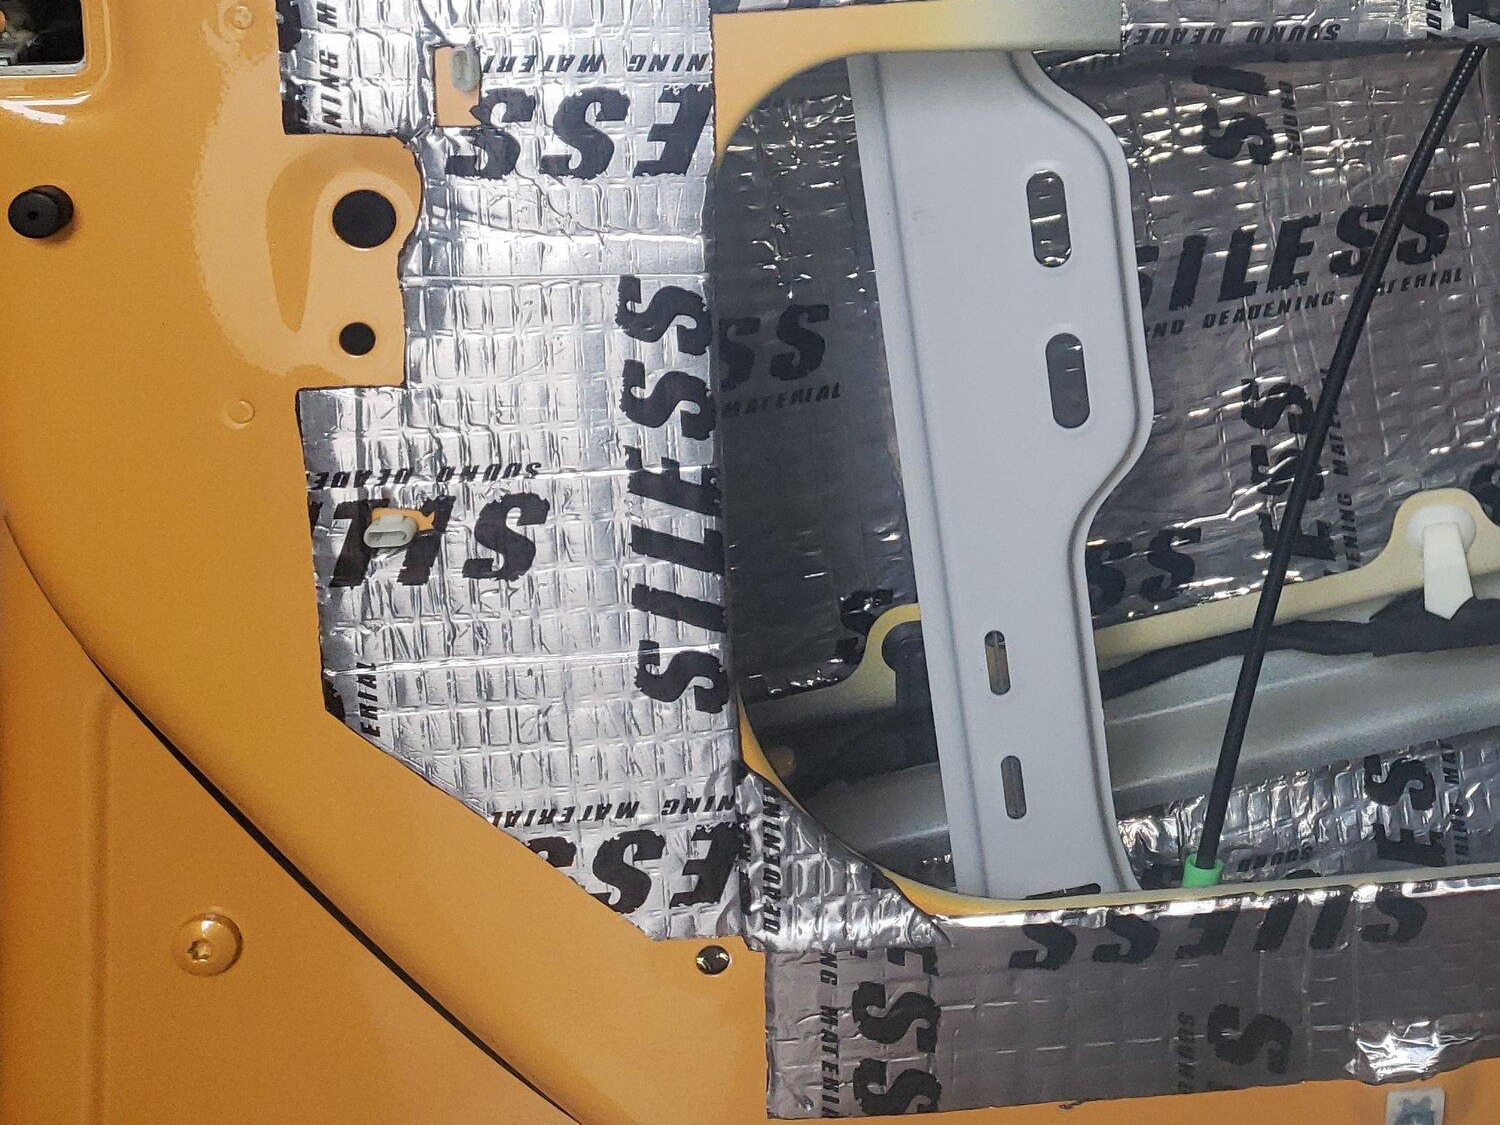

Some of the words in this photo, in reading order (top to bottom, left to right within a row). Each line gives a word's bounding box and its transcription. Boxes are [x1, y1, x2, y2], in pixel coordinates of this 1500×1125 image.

[1245, 22, 1341, 44] SOUND
[626, 51, 709, 74] NING
[1202, 290, 1336, 329] DEADENING
[722, 381, 841, 421] MATERIAL
[436, 461, 542, 484] SOUND
[615, 275, 731, 715] SILESS
[492, 797, 641, 828] MATERIAL
[661, 792, 736, 816] NING
